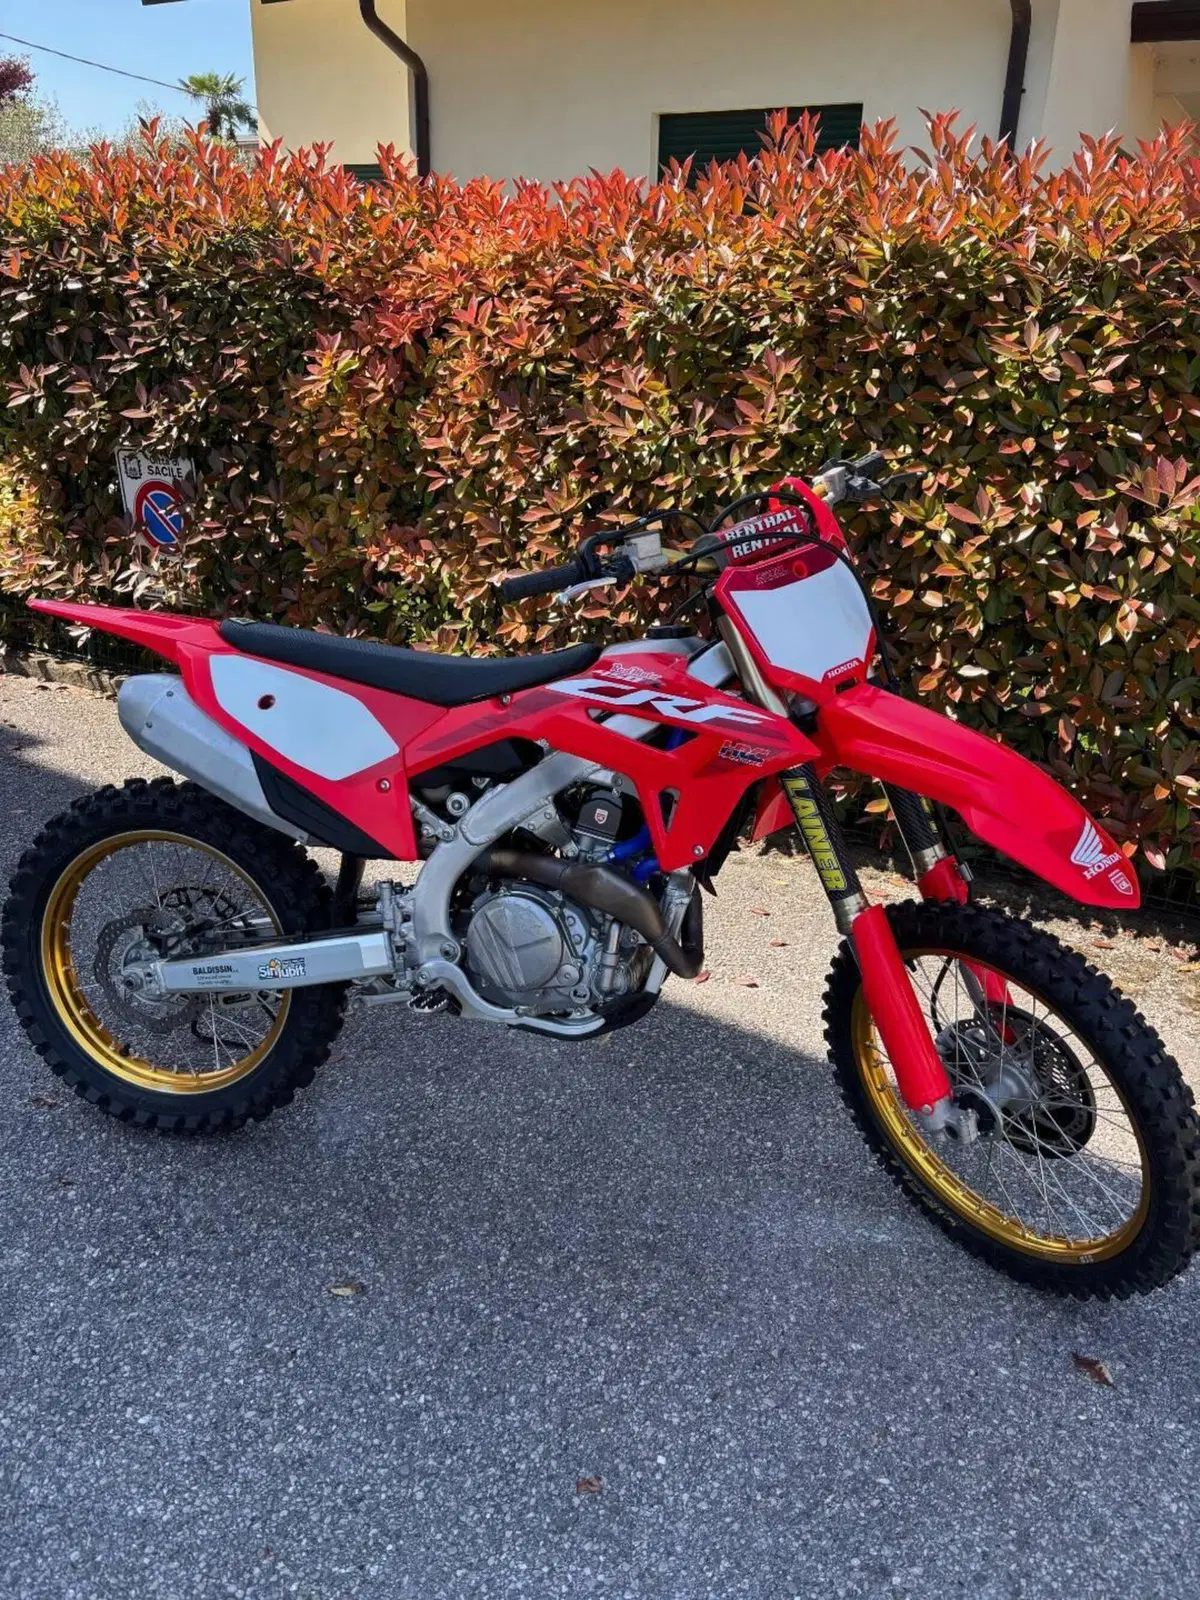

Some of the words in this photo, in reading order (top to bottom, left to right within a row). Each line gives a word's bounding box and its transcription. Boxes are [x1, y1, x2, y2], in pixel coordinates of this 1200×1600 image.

[147, 465, 183, 478] SACILE
[724, 509, 796, 541] RENTHAL
[731, 522, 804, 559] RENAL
[827, 660, 860, 679] HONDA
[780, 778, 847, 890] LAINER
[1082, 852, 1123, 881] HONDA
